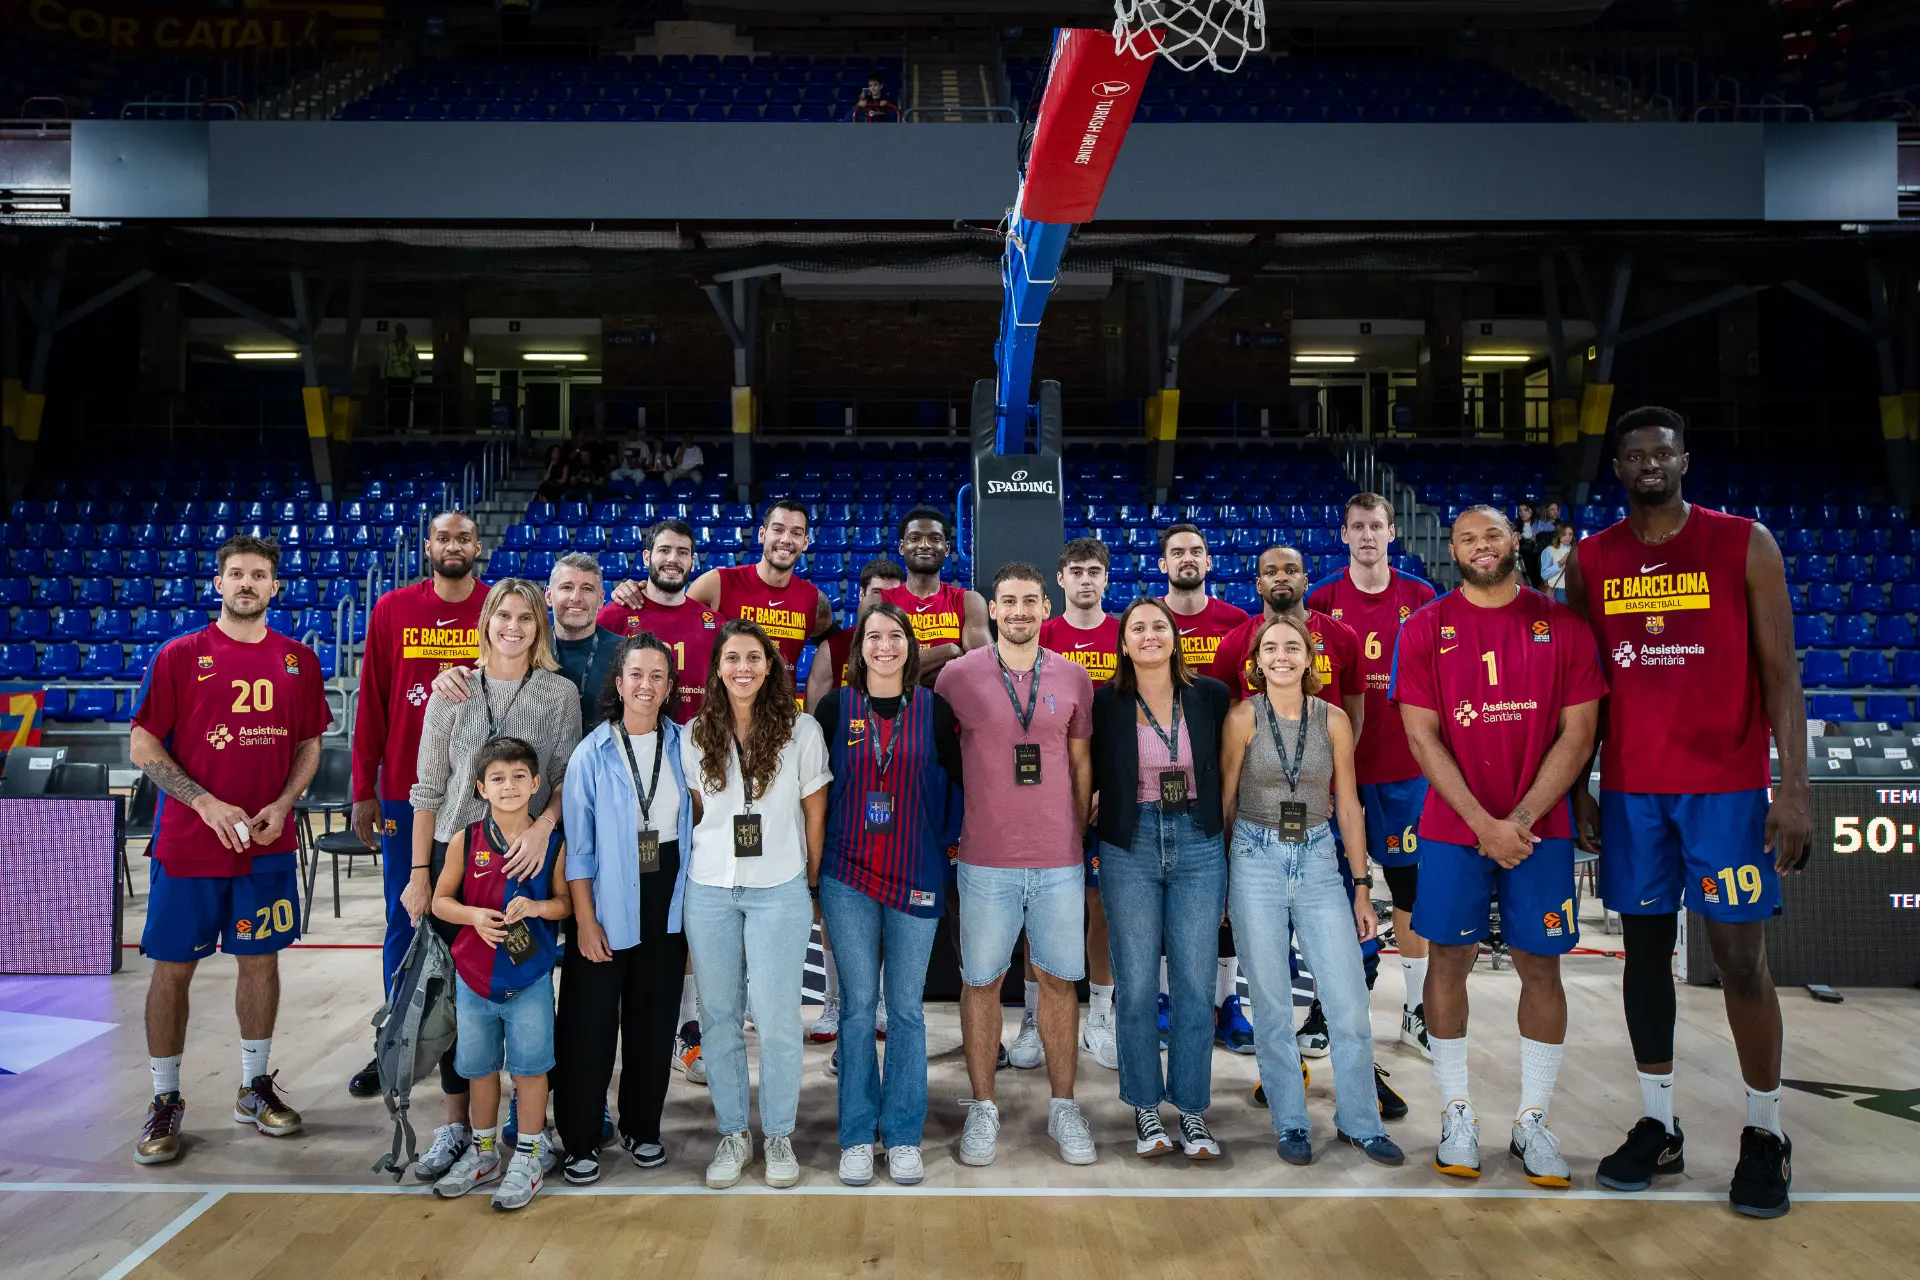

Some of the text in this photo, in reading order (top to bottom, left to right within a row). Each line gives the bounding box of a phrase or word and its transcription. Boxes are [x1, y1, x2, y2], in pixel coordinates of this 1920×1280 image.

[28, 0, 139, 47] COR
[1073, 100, 1114, 165] TURKISH AIRLINES
[987, 480, 1053, 494] SPALDING
[1604, 571, 1710, 600] FC BARCELONA
[740, 605, 806, 629] FC BARCELONA
[1625, 599, 1683, 610] BASKETBALL
[403, 627, 480, 646] FC BARCELON
[764, 627, 794, 637] SKETBALL
[1180, 635, 1224, 653] RCELON
[661, 641, 685, 671] 1
[1364, 632, 1382, 660] 6
[1640, 643, 1706, 655] Assistència
[1061, 651, 1118, 669] ARCELON
[1481, 651, 1498, 686] 1
[1640, 654, 1685, 666] Sanitària
[231, 678, 274, 713] 20
[1481, 699, 1538, 713] Assistència
[1482, 711, 1522, 723] Sanitària
[1876, 789, 1920, 804] TEM
[1402, 825, 1418, 853] 6
[1833, 816, 1920, 854] 50:
[1717, 864, 1762, 906] 19
[254, 899, 294, 940] 20
[1561, 898, 1576, 935] 1
